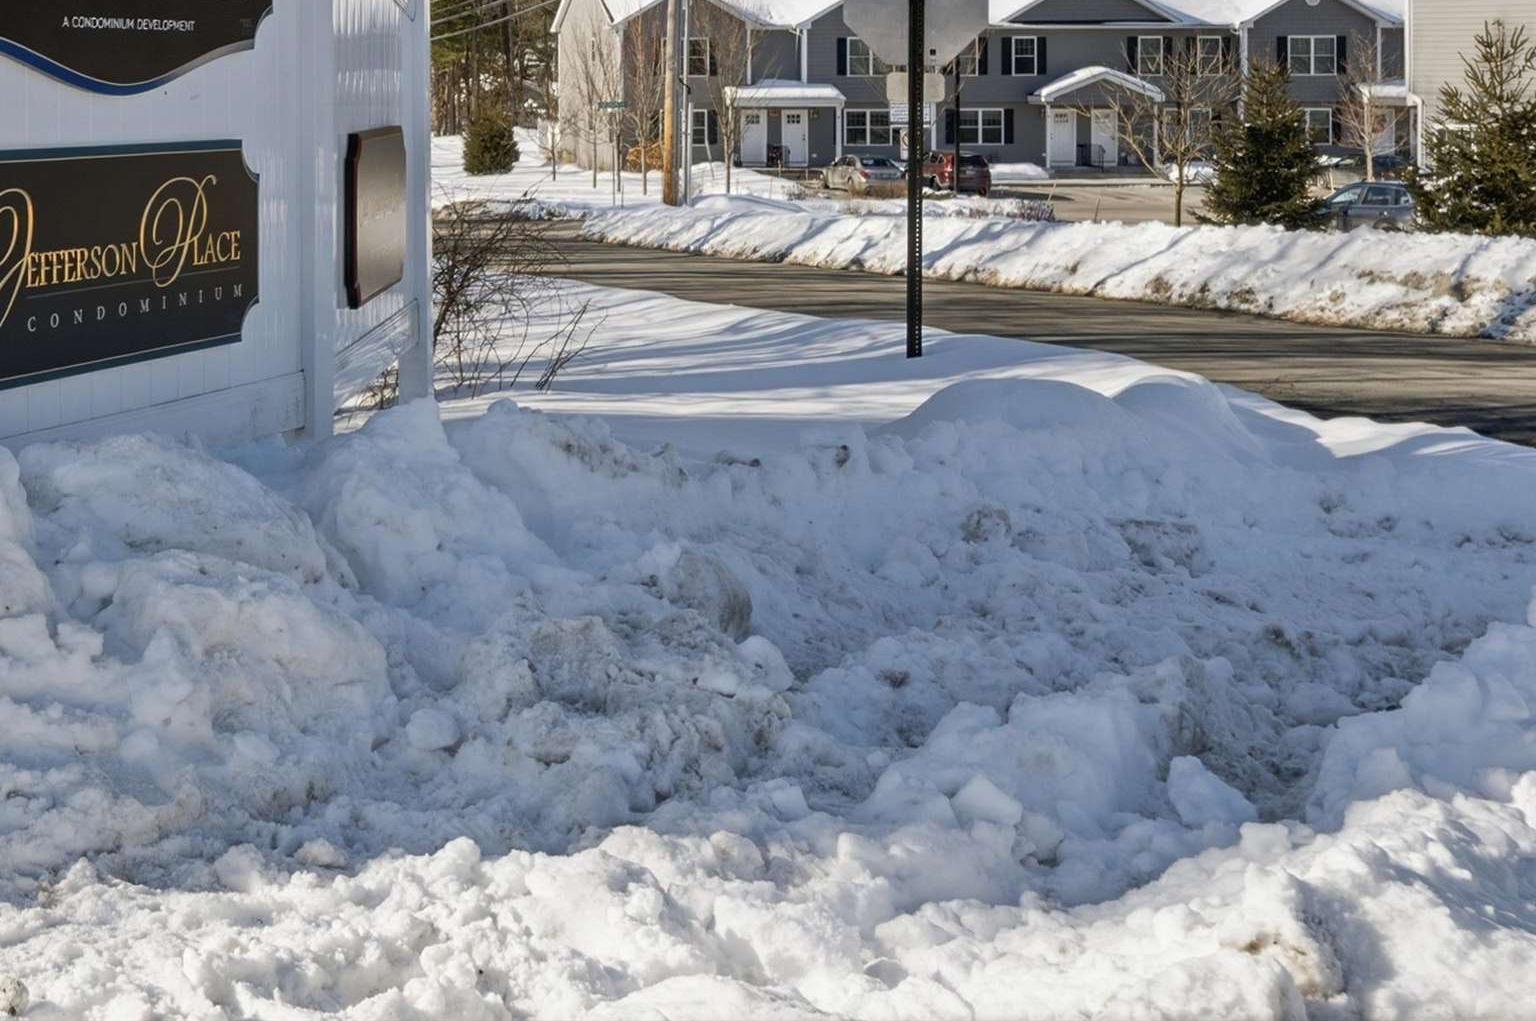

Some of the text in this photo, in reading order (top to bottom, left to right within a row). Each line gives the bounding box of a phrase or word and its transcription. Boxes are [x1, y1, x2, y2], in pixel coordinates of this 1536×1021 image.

[62, 16, 195, 32] A CONDOMINIUM DEVELOPMENT
[27, 286, 243, 332] CONDOMINIUM
